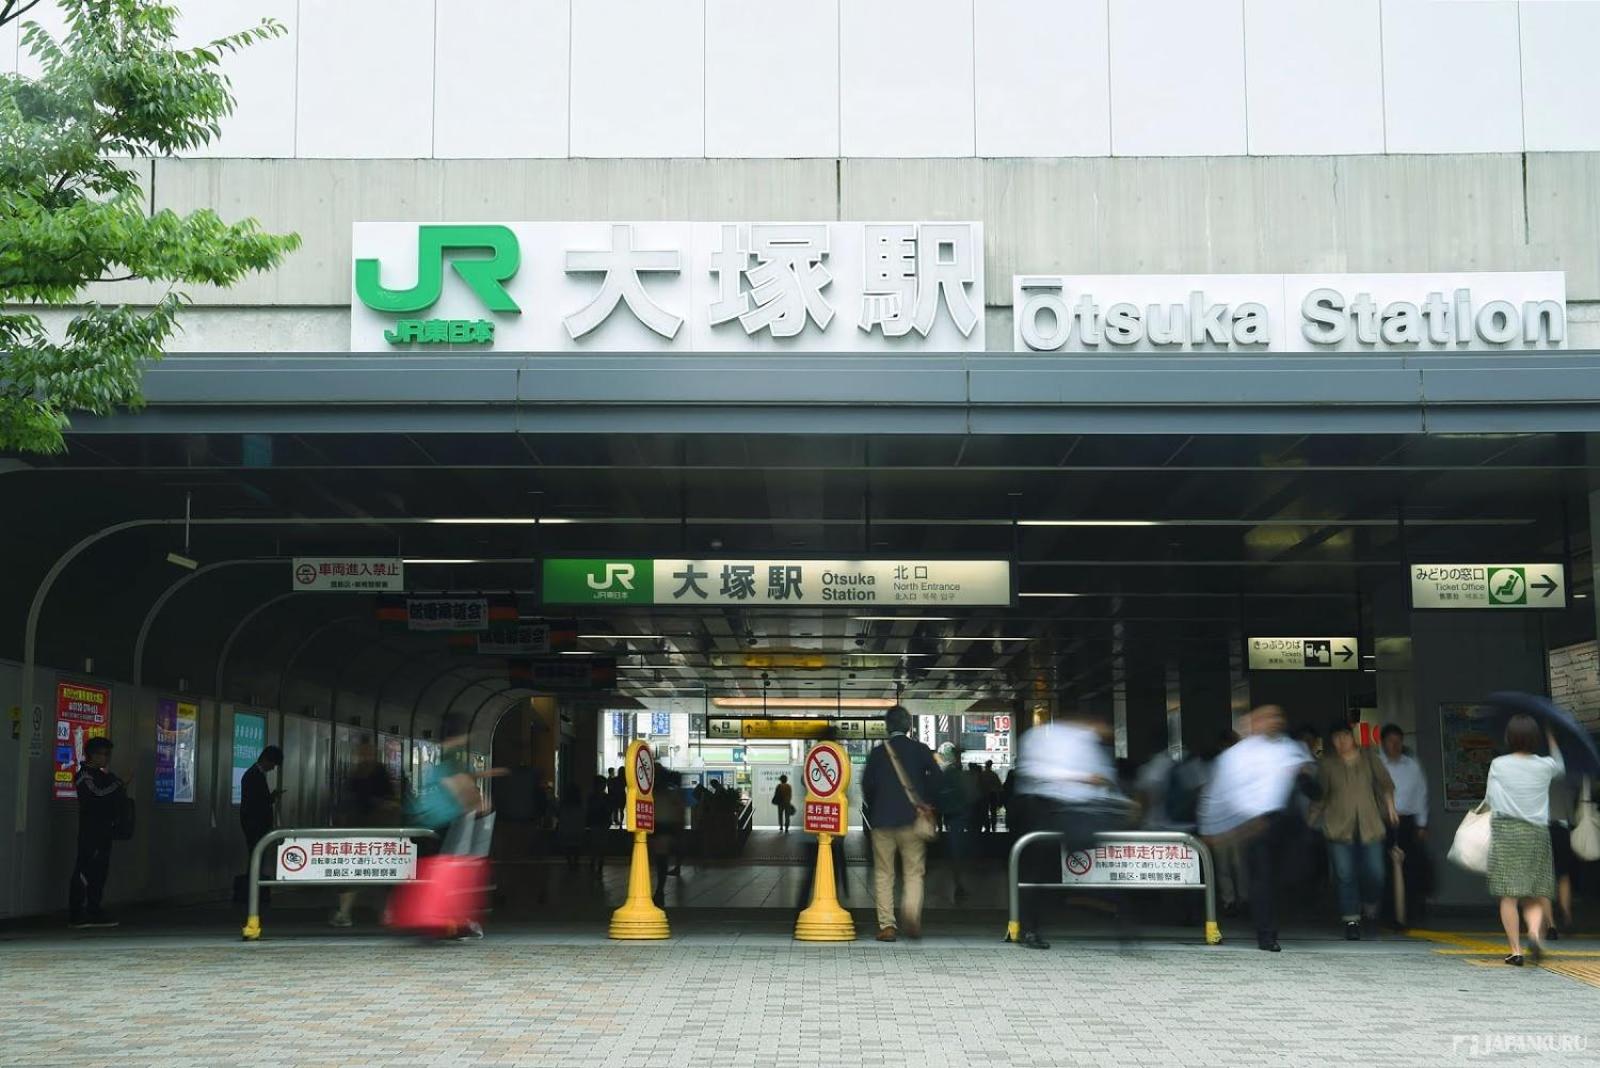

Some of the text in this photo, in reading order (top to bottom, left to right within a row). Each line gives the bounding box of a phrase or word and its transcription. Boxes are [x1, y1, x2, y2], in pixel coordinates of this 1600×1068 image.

[355, 225, 521, 314] JR
[563, 223, 978, 339] 大塚駅
[1300, 287, 1563, 346] Station
[384, 318, 495, 345] JR東日本
[319, 562, 400, 576] 車両進入禁止
[587, 563, 635, 590] JR
[894, 565, 928, 580] 北口
[1416, 568, 1485, 581] みどりの窓口
[672, 564, 804, 600] 大塚駅
[894, 582, 961, 591] North Entrance
[1435, 583, 1486, 591] Ticket Office
[822, 587, 876, 601] Station
[993, 715, 1010, 730] 19
[311, 842, 412, 856] 自転車走行禁止
[1095, 845, 1194, 860] 自転車走行禁止
